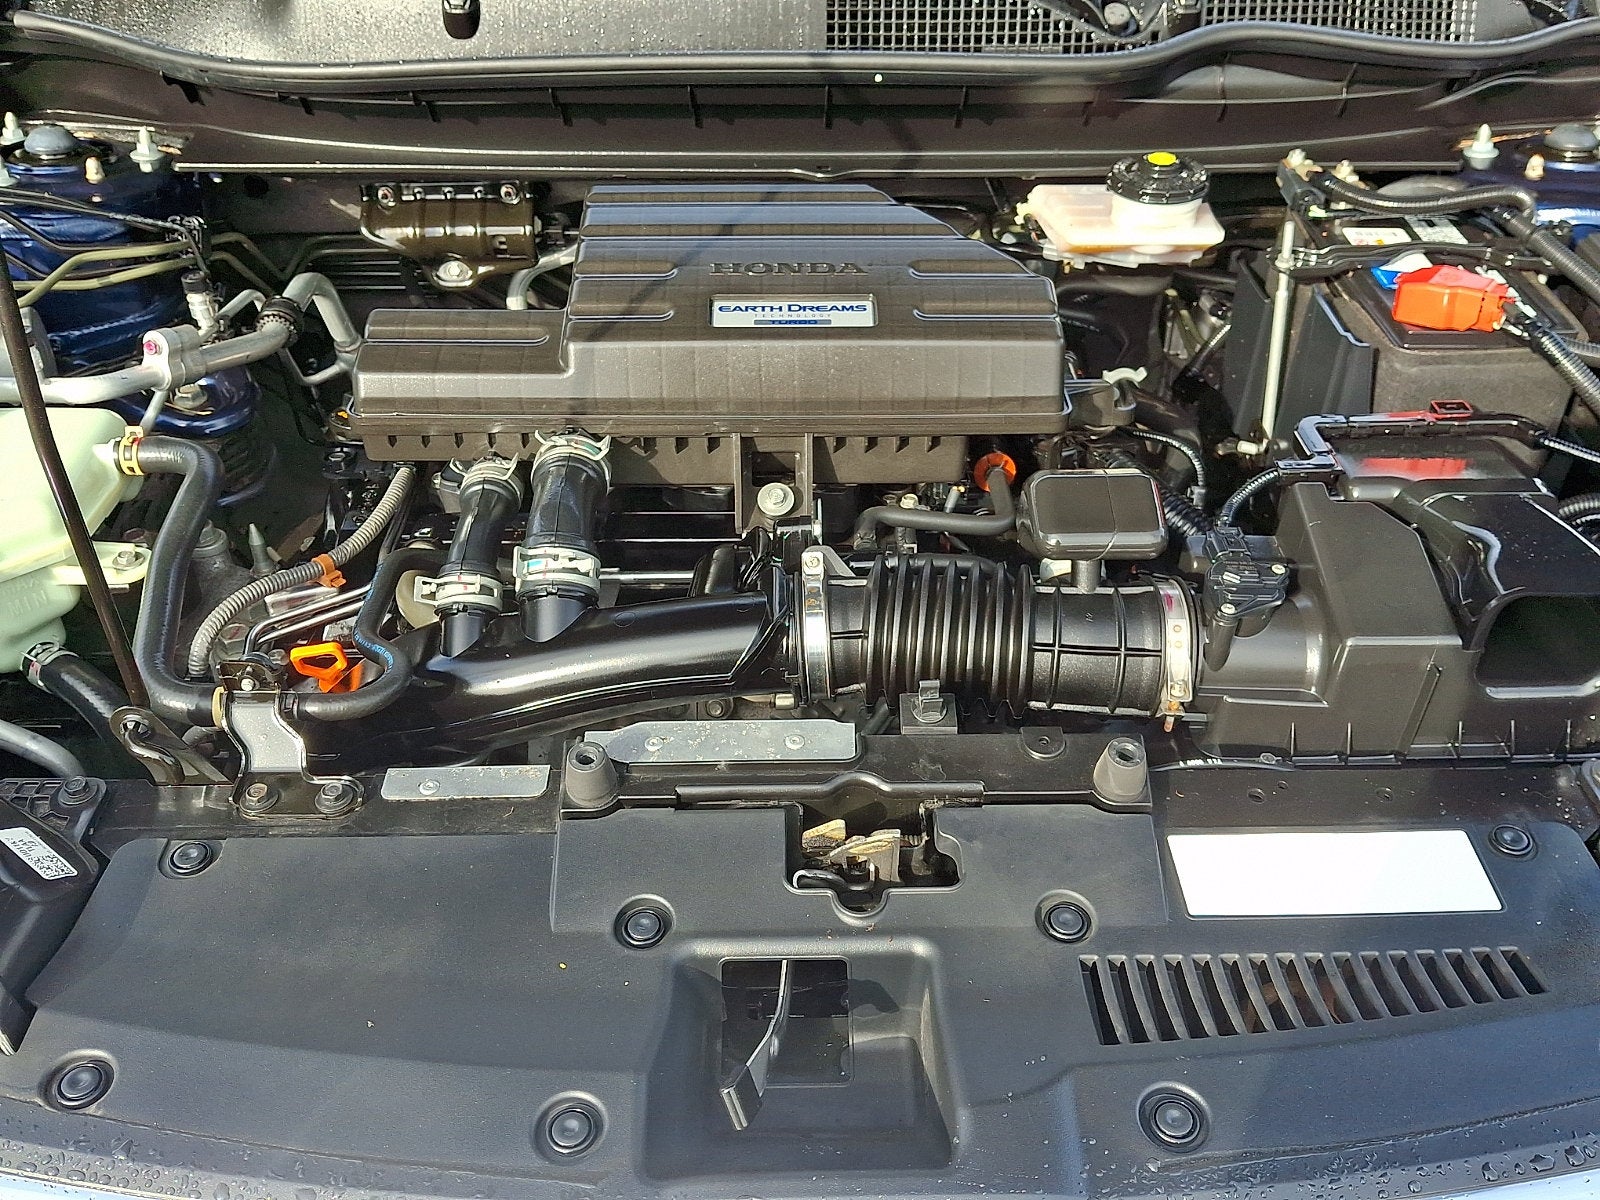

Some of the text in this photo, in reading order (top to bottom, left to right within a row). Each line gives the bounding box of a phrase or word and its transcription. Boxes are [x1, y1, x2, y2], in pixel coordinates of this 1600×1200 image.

[709, 262, 869, 276] HONDA
[718, 304, 867, 312] EARTH DREAMS
[7, 590, 48, 616] MIN
